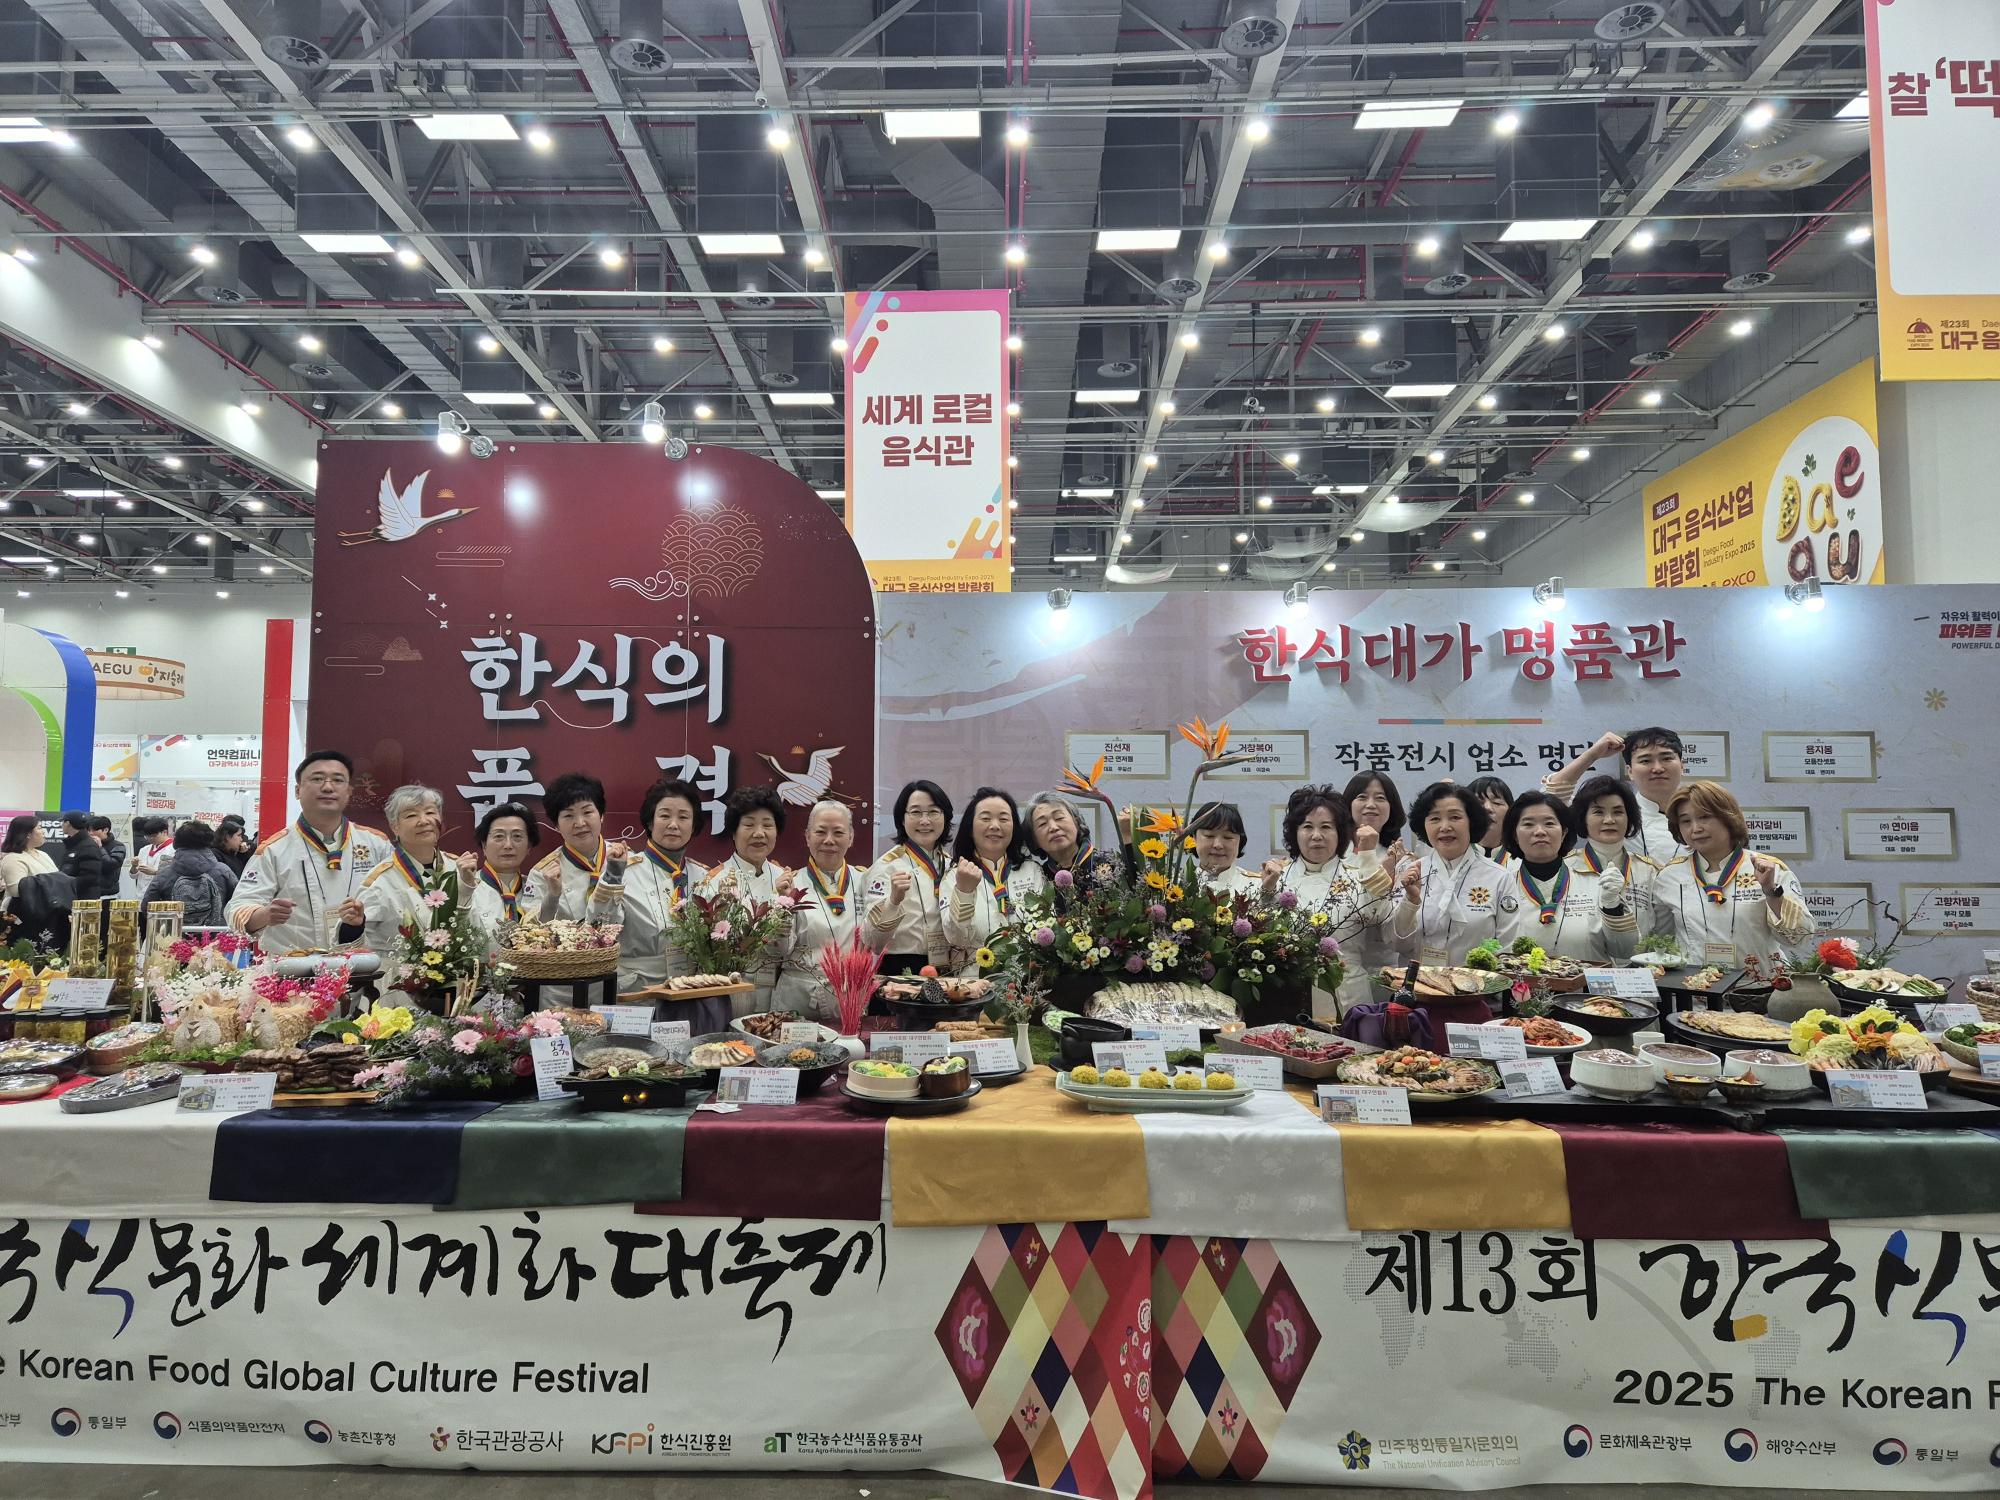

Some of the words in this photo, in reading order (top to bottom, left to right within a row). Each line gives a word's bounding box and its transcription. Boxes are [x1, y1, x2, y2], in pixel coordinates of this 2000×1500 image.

[1941, 331, 1979, 350] 대구
[862, 395, 923, 425] 세계
[933, 393, 993, 424] 로컬
[881, 435, 975, 467] 음식관
[1653, 517, 1681, 555] 대구
[1685, 481, 1754, 543] 음식산업
[1720, 537, 1734, 550] Food
[1725, 549, 1739, 560] Expo
[1740, 540, 1756, 553] 2025
[1654, 547, 1700, 587] 박람회
[1941, 611, 1969, 621] 자유와
[1239, 622, 1484, 683] 한식대가
[1503, 619, 1687, 683] 명품관
[461, 632, 726, 723] 한식의
[1104, 743, 1131, 752] 진선재
[1239, 743, 1273, 752] 거창복어
[1335, 741, 1455, 773] 작품전시
[1468, 741, 1530, 771] 업소
[1745, 820, 1782, 830] 돼지갈비
[1891, 822, 1919, 831] 연이음
[1804, 896, 1834, 906] 사다라
[1365, 1230, 1597, 1320] 제13회
[19, 1349, 134, 1381] Korean
[149, 1355, 230, 1387] Food
[244, 1360, 355, 1392] Global
[370, 1361, 498, 1393] Culture
[513, 1361, 649, 1394] Festival
[1613, 1369, 1734, 1408] 2025
[1755, 1378, 1825, 1406] The
[1843, 1378, 1972, 1410] Korean
[88, 1415, 127, 1430] 통일부
[188, 1419, 286, 1435] 식품의약품안전처
[338, 1429, 396, 1447] 농촌진흥청
[456, 1430, 564, 1453] 한국관광공사
[660, 1433, 731, 1452] 한식진흥원
[764, 1432, 792, 1453] aT
[797, 1432, 923, 1447] 한국농수산식품유통공사
[1378, 1435, 1519, 1455] 민주평화통일자문회의
[1600, 1434, 1692, 1451] 문화체육관광부
[889, 1447, 922, 1455] Corporation
[1765, 1439, 1837, 1456] 해양수산부
[1915, 1448, 1959, 1462] 통일부
[1383, 1460, 1396, 1470] The
[1397, 1460, 1427, 1469] National
[1427, 1459, 1464, 1469] Unification
[1466, 1458, 1494, 1468] Advisory
[1496, 1457, 1521, 1466] Council
